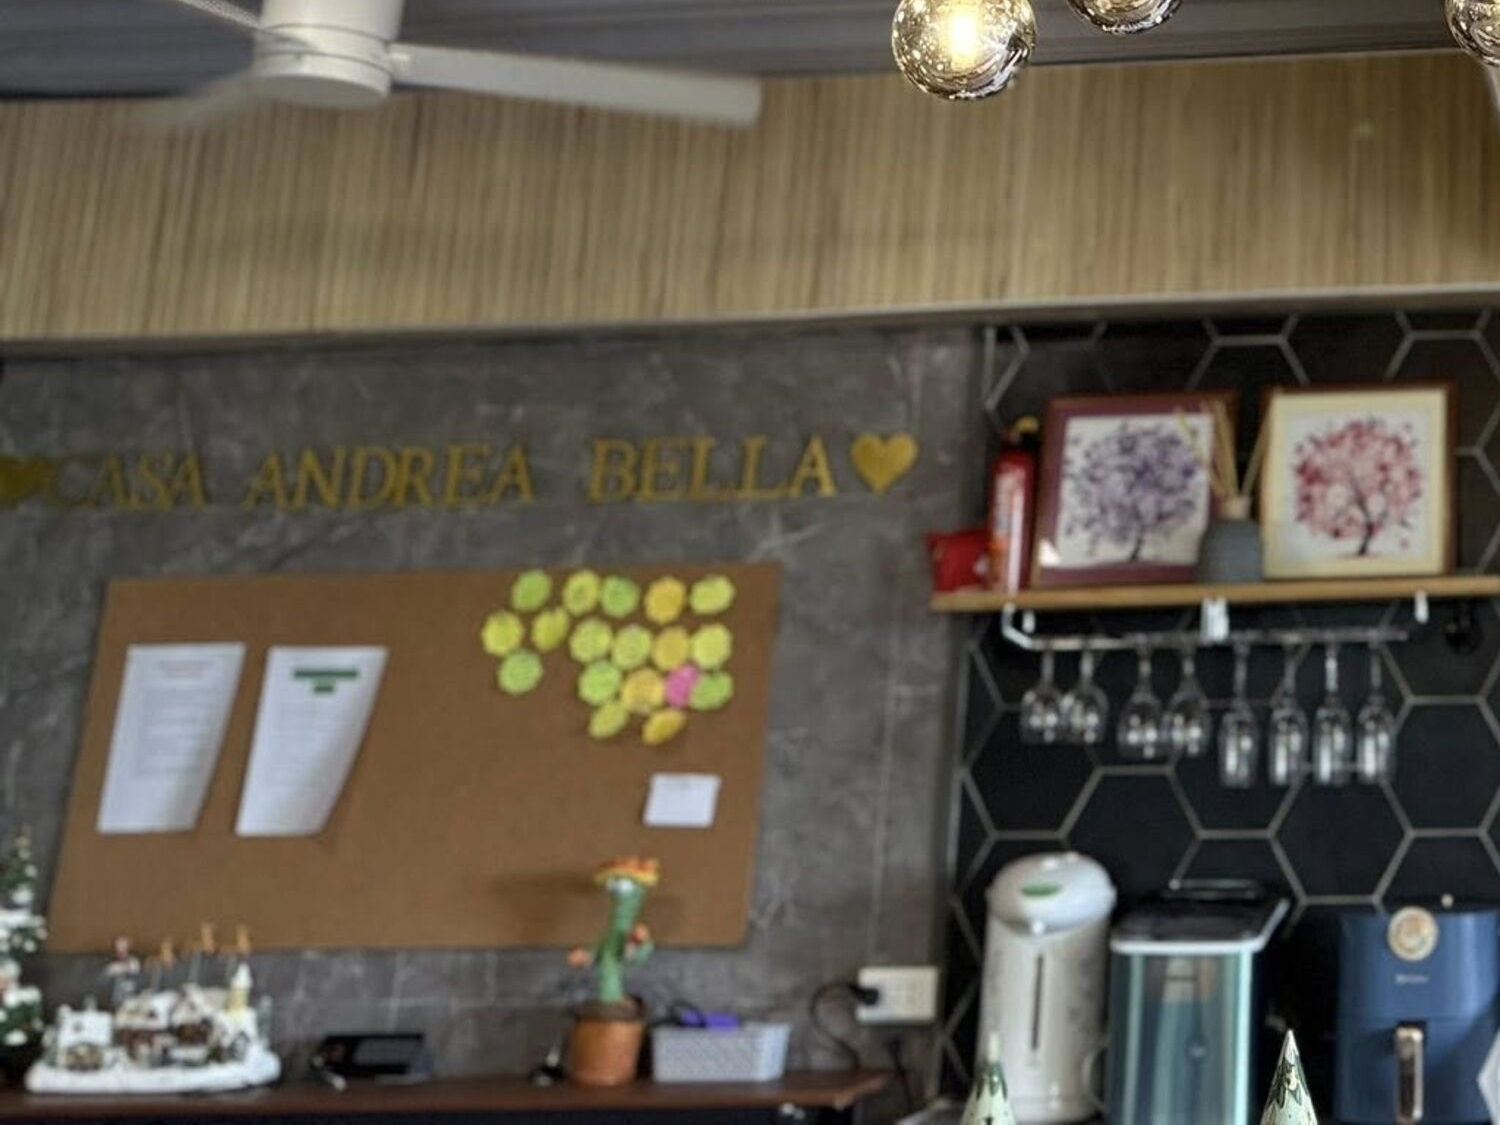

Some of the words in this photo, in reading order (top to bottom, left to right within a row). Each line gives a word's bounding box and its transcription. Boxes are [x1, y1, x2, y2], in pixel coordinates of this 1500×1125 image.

[47, 451, 210, 512] CASA
[241, 443, 537, 513] ANDREA
[588, 434, 839, 504] BELLA
